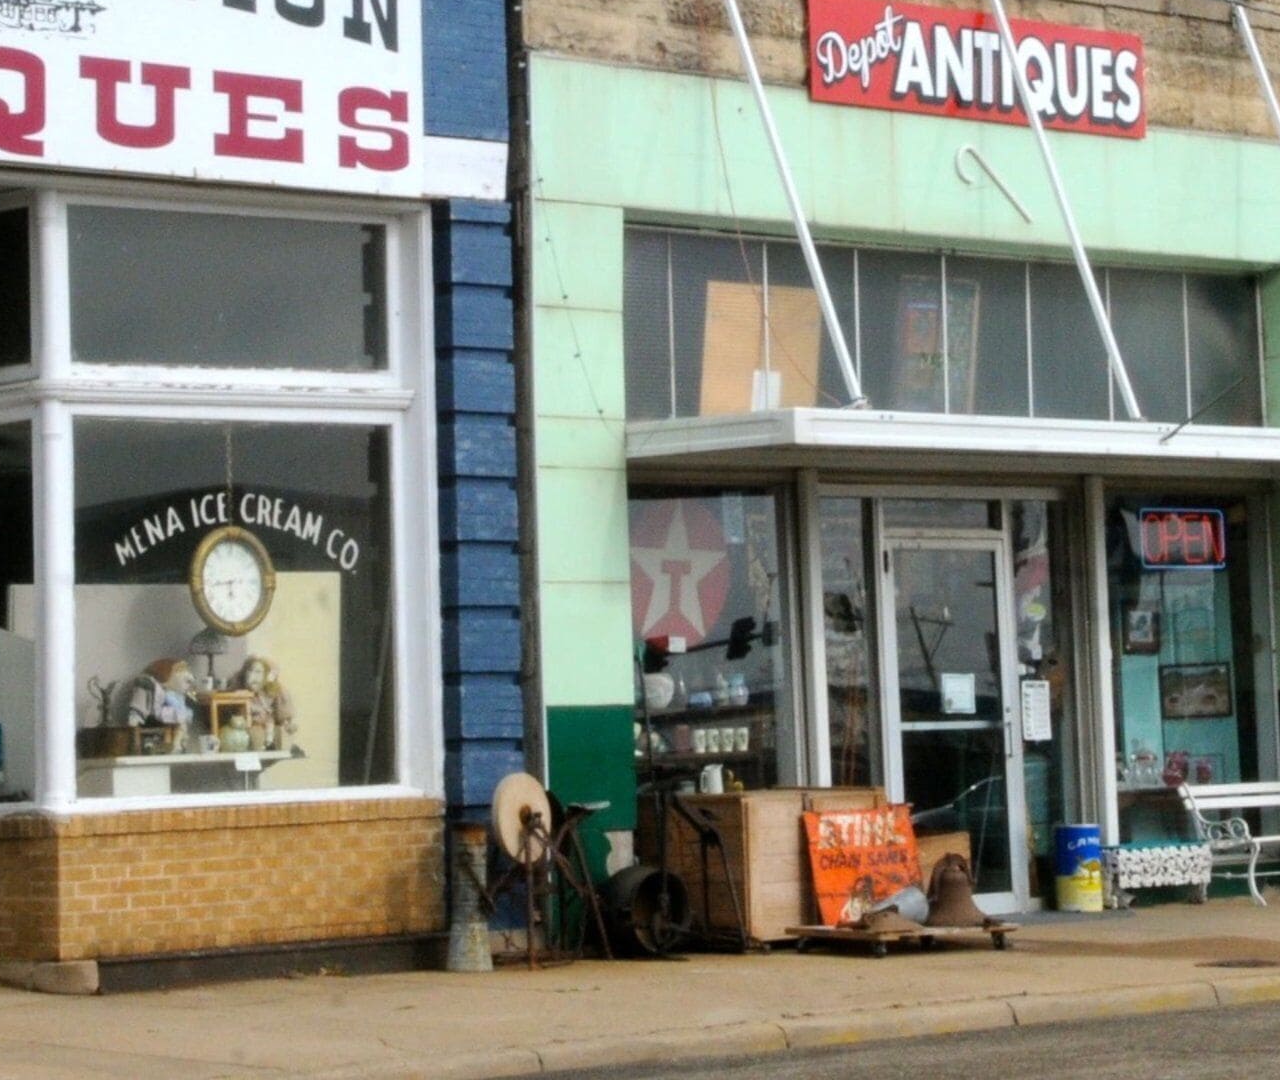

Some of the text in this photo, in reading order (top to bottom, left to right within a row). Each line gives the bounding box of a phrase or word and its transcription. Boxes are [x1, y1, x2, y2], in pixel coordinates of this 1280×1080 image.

[816, 5, 1141, 123] Depot ANTIQUES
[114, 506, 185, 566] MENA
[190, 492, 228, 528] ICE
[240, 493, 323, 546] CREAM
[1144, 512, 1224, 564] OPEN
